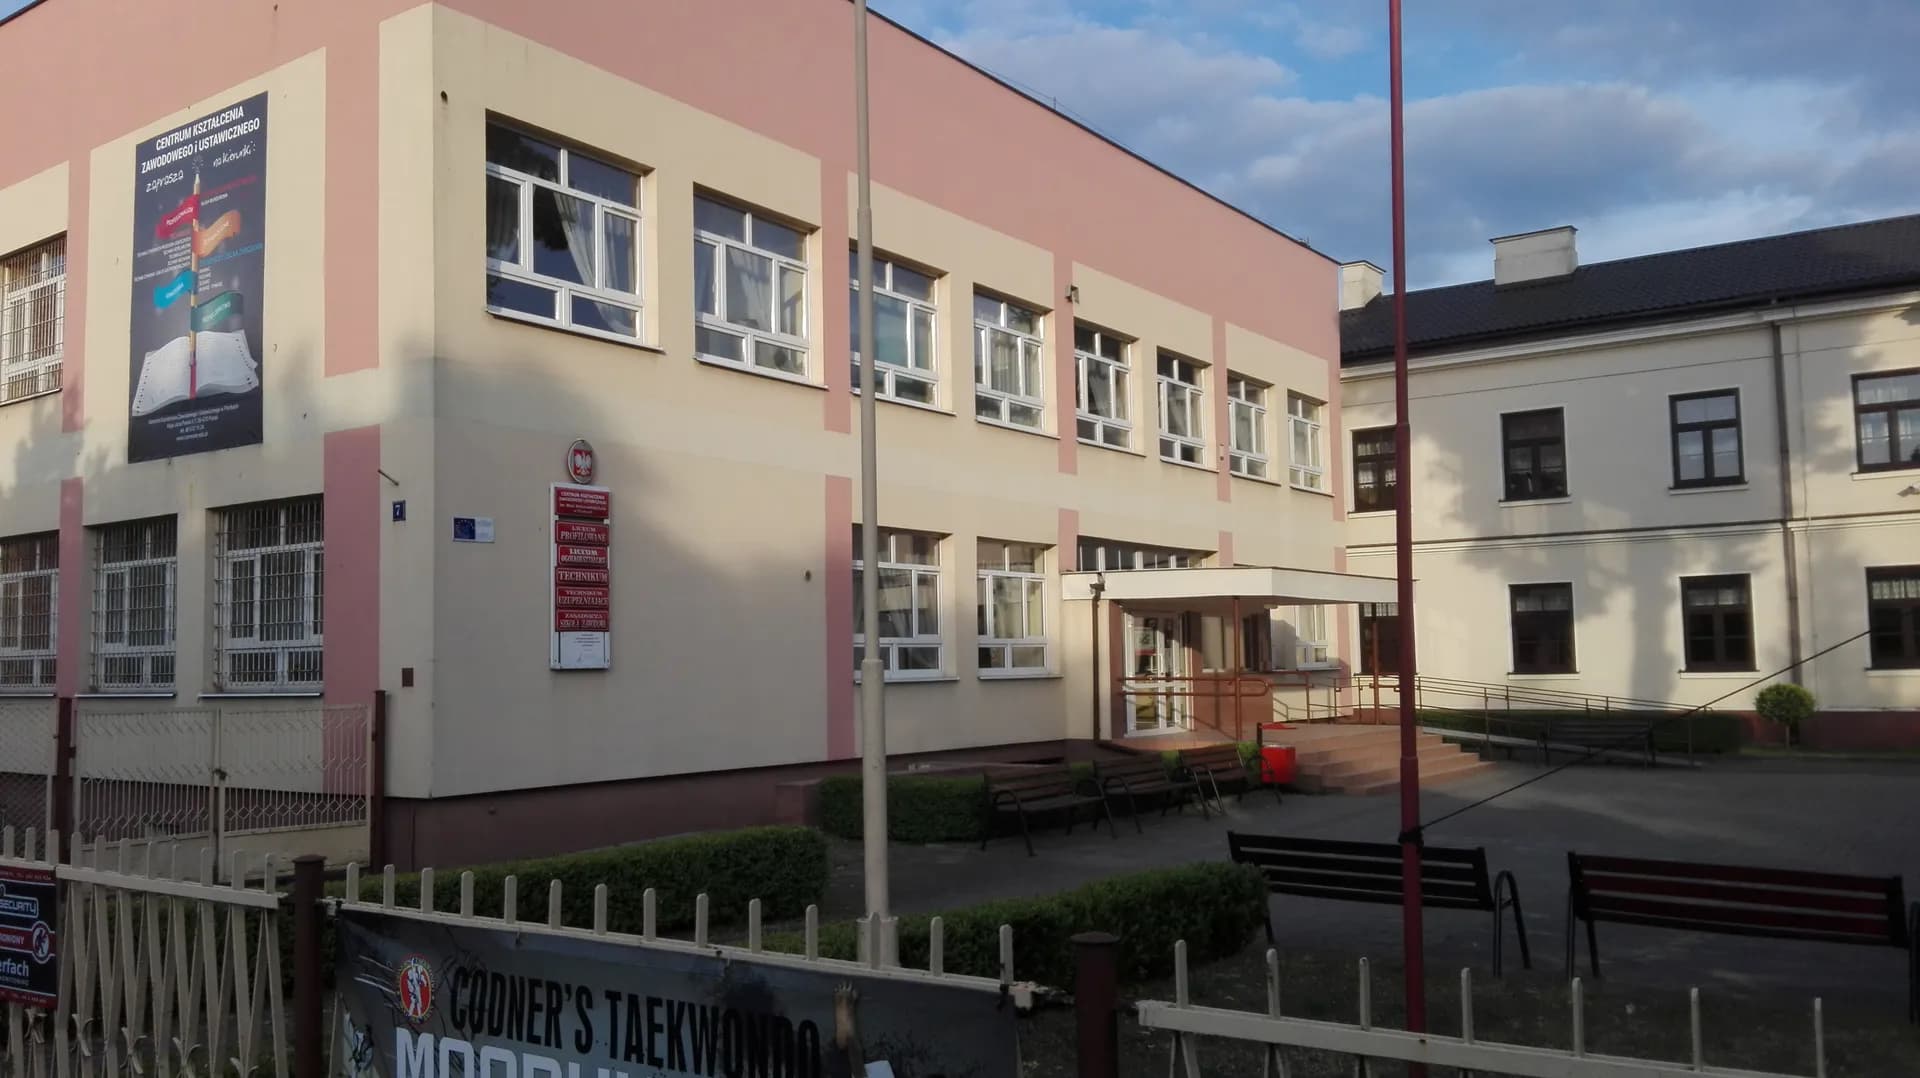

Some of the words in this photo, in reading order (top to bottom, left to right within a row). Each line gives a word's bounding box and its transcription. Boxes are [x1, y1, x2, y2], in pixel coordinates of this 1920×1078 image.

[156, 126, 192, 151] CENTRUM
[192, 105, 244, 137] KSZTAŁCENIA
[141, 143, 193, 174] ZAWODOWEGO
[198, 117, 261, 151] USTAWICZNEGO
[145, 169, 184, 193] zaprasza
[395, 504, 401, 516] 7
[560, 530, 607, 542] PROFILOWANE
[569, 548, 598, 556] LICEUM
[558, 571, 608, 583] TECHNIKUM
[450, 966, 594, 1054] CODNER'S
[604, 989, 822, 1078] TAEKWONDO
